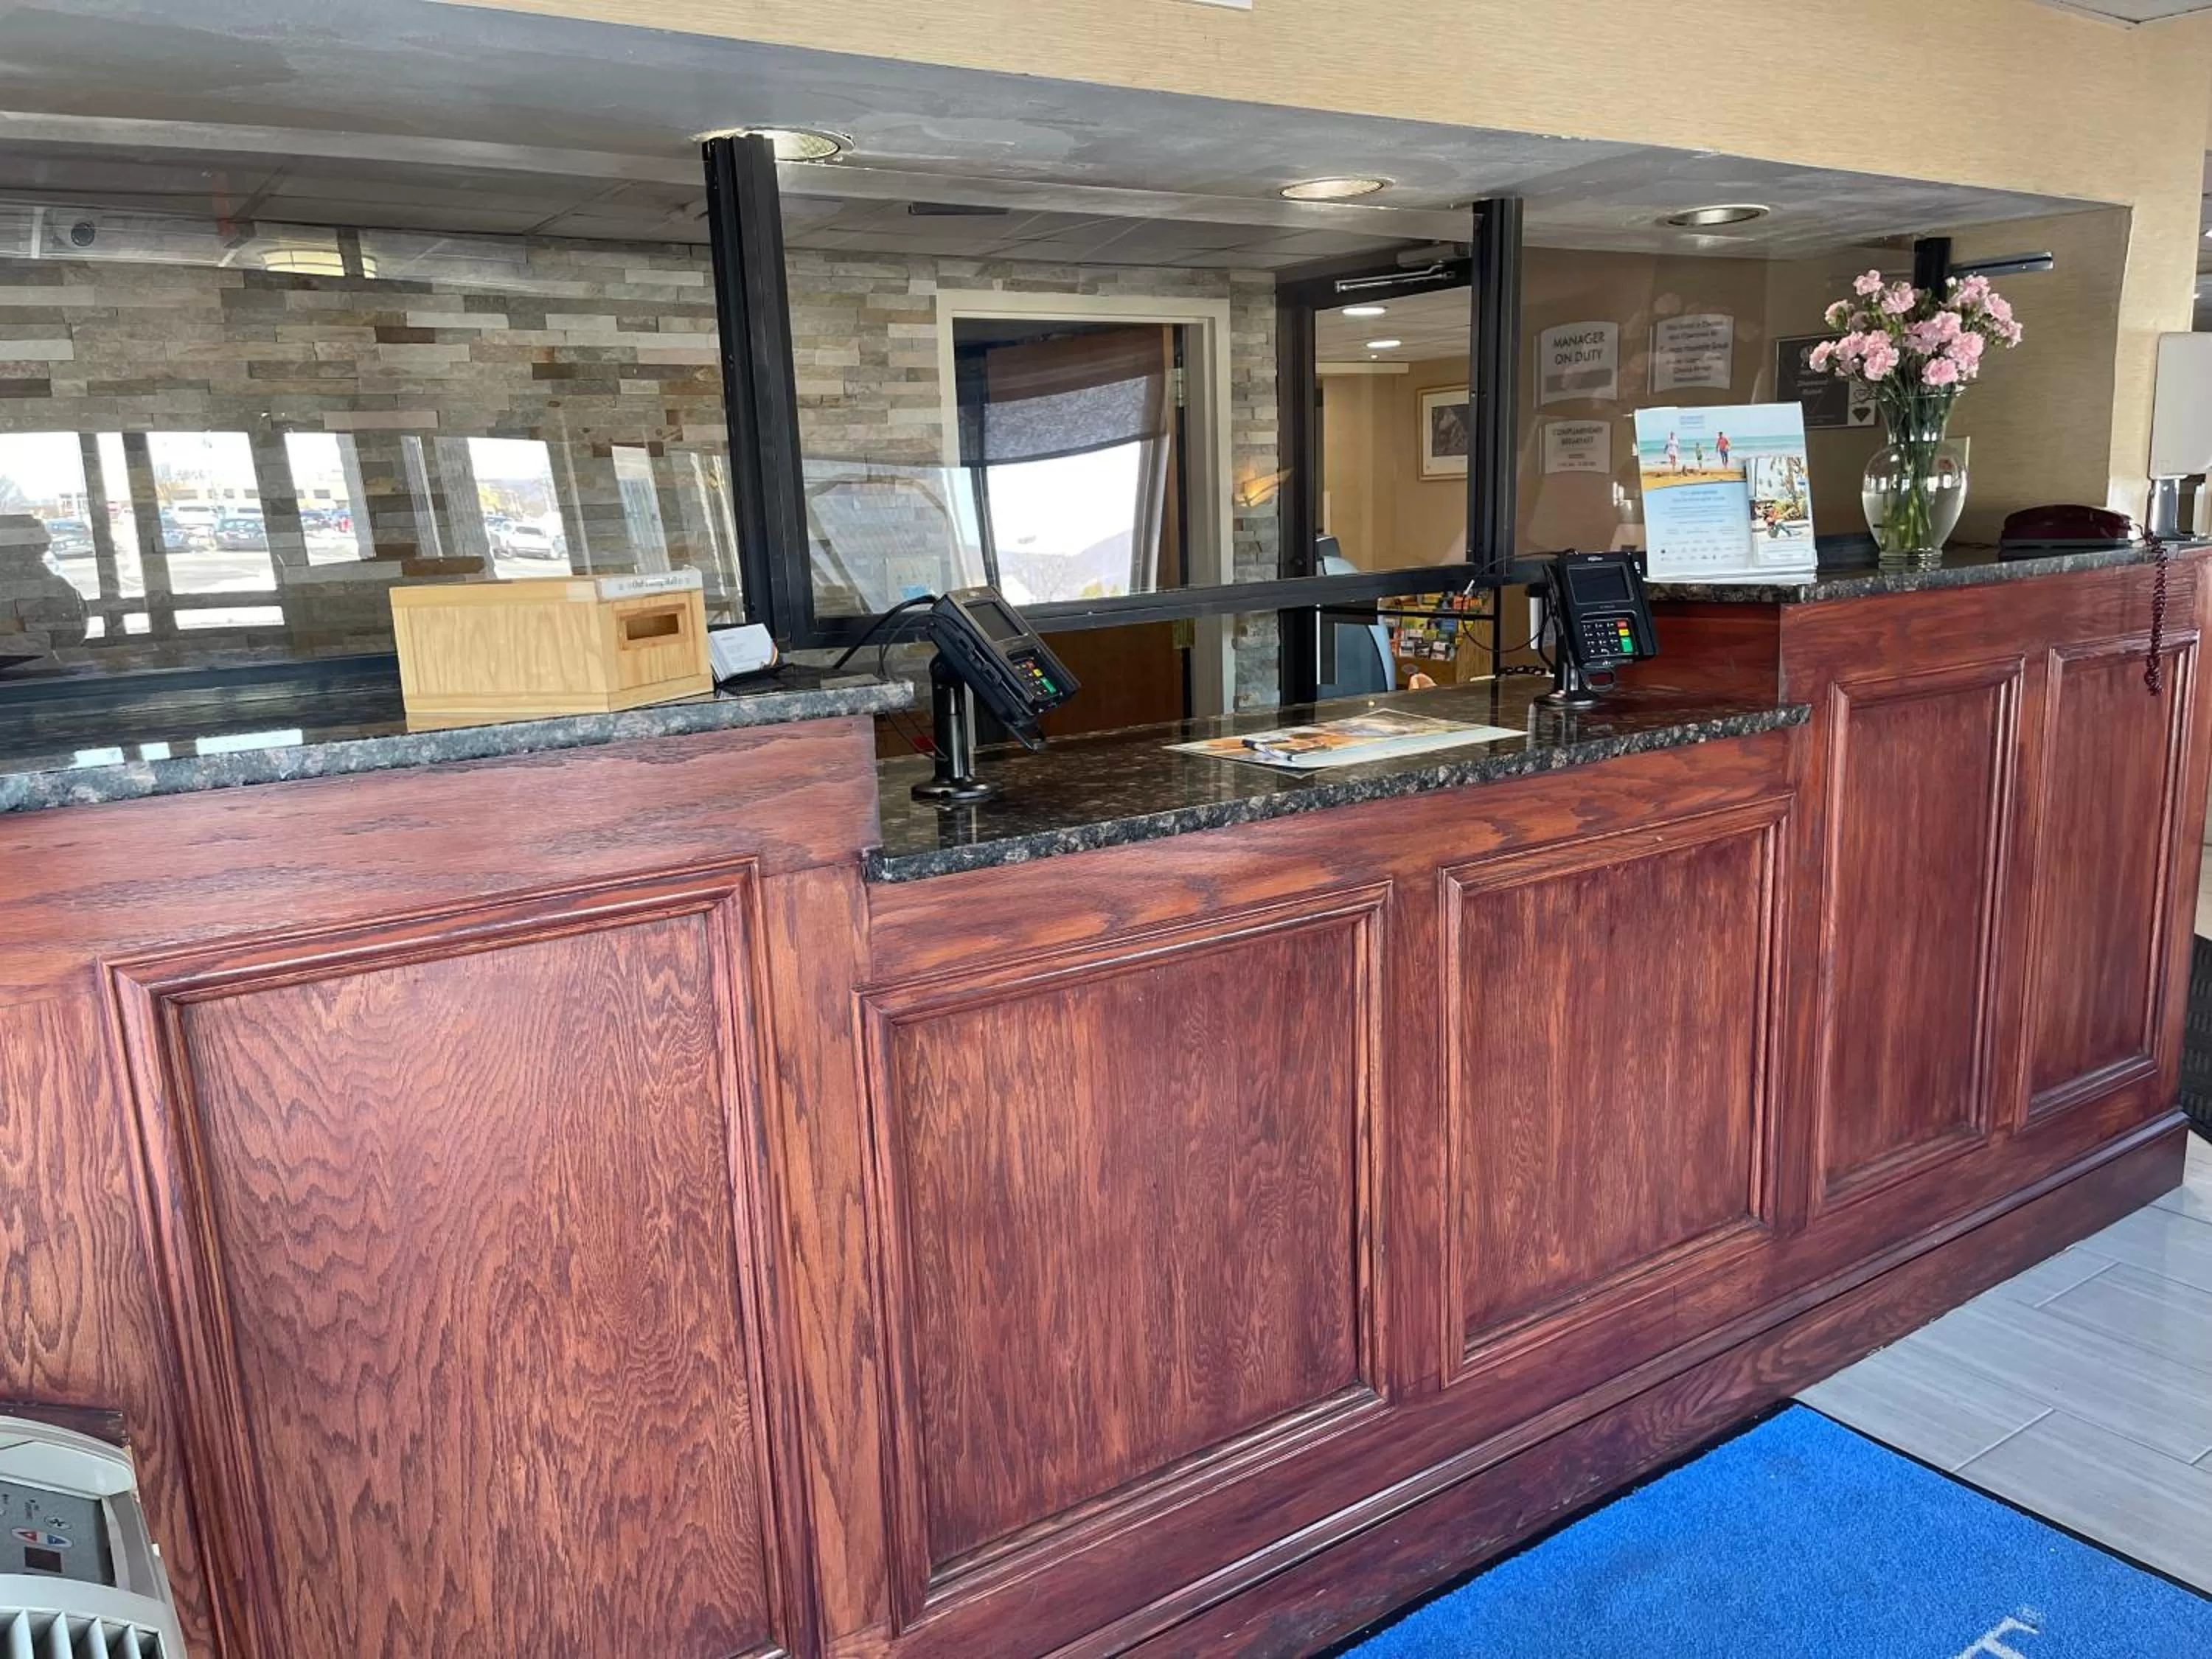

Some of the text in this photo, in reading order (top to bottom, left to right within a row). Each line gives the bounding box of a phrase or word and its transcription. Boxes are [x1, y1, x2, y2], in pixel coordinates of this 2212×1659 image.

[1554, 331, 1605, 349] MANAGER
[1554, 349, 1603, 366] ON DUTY
